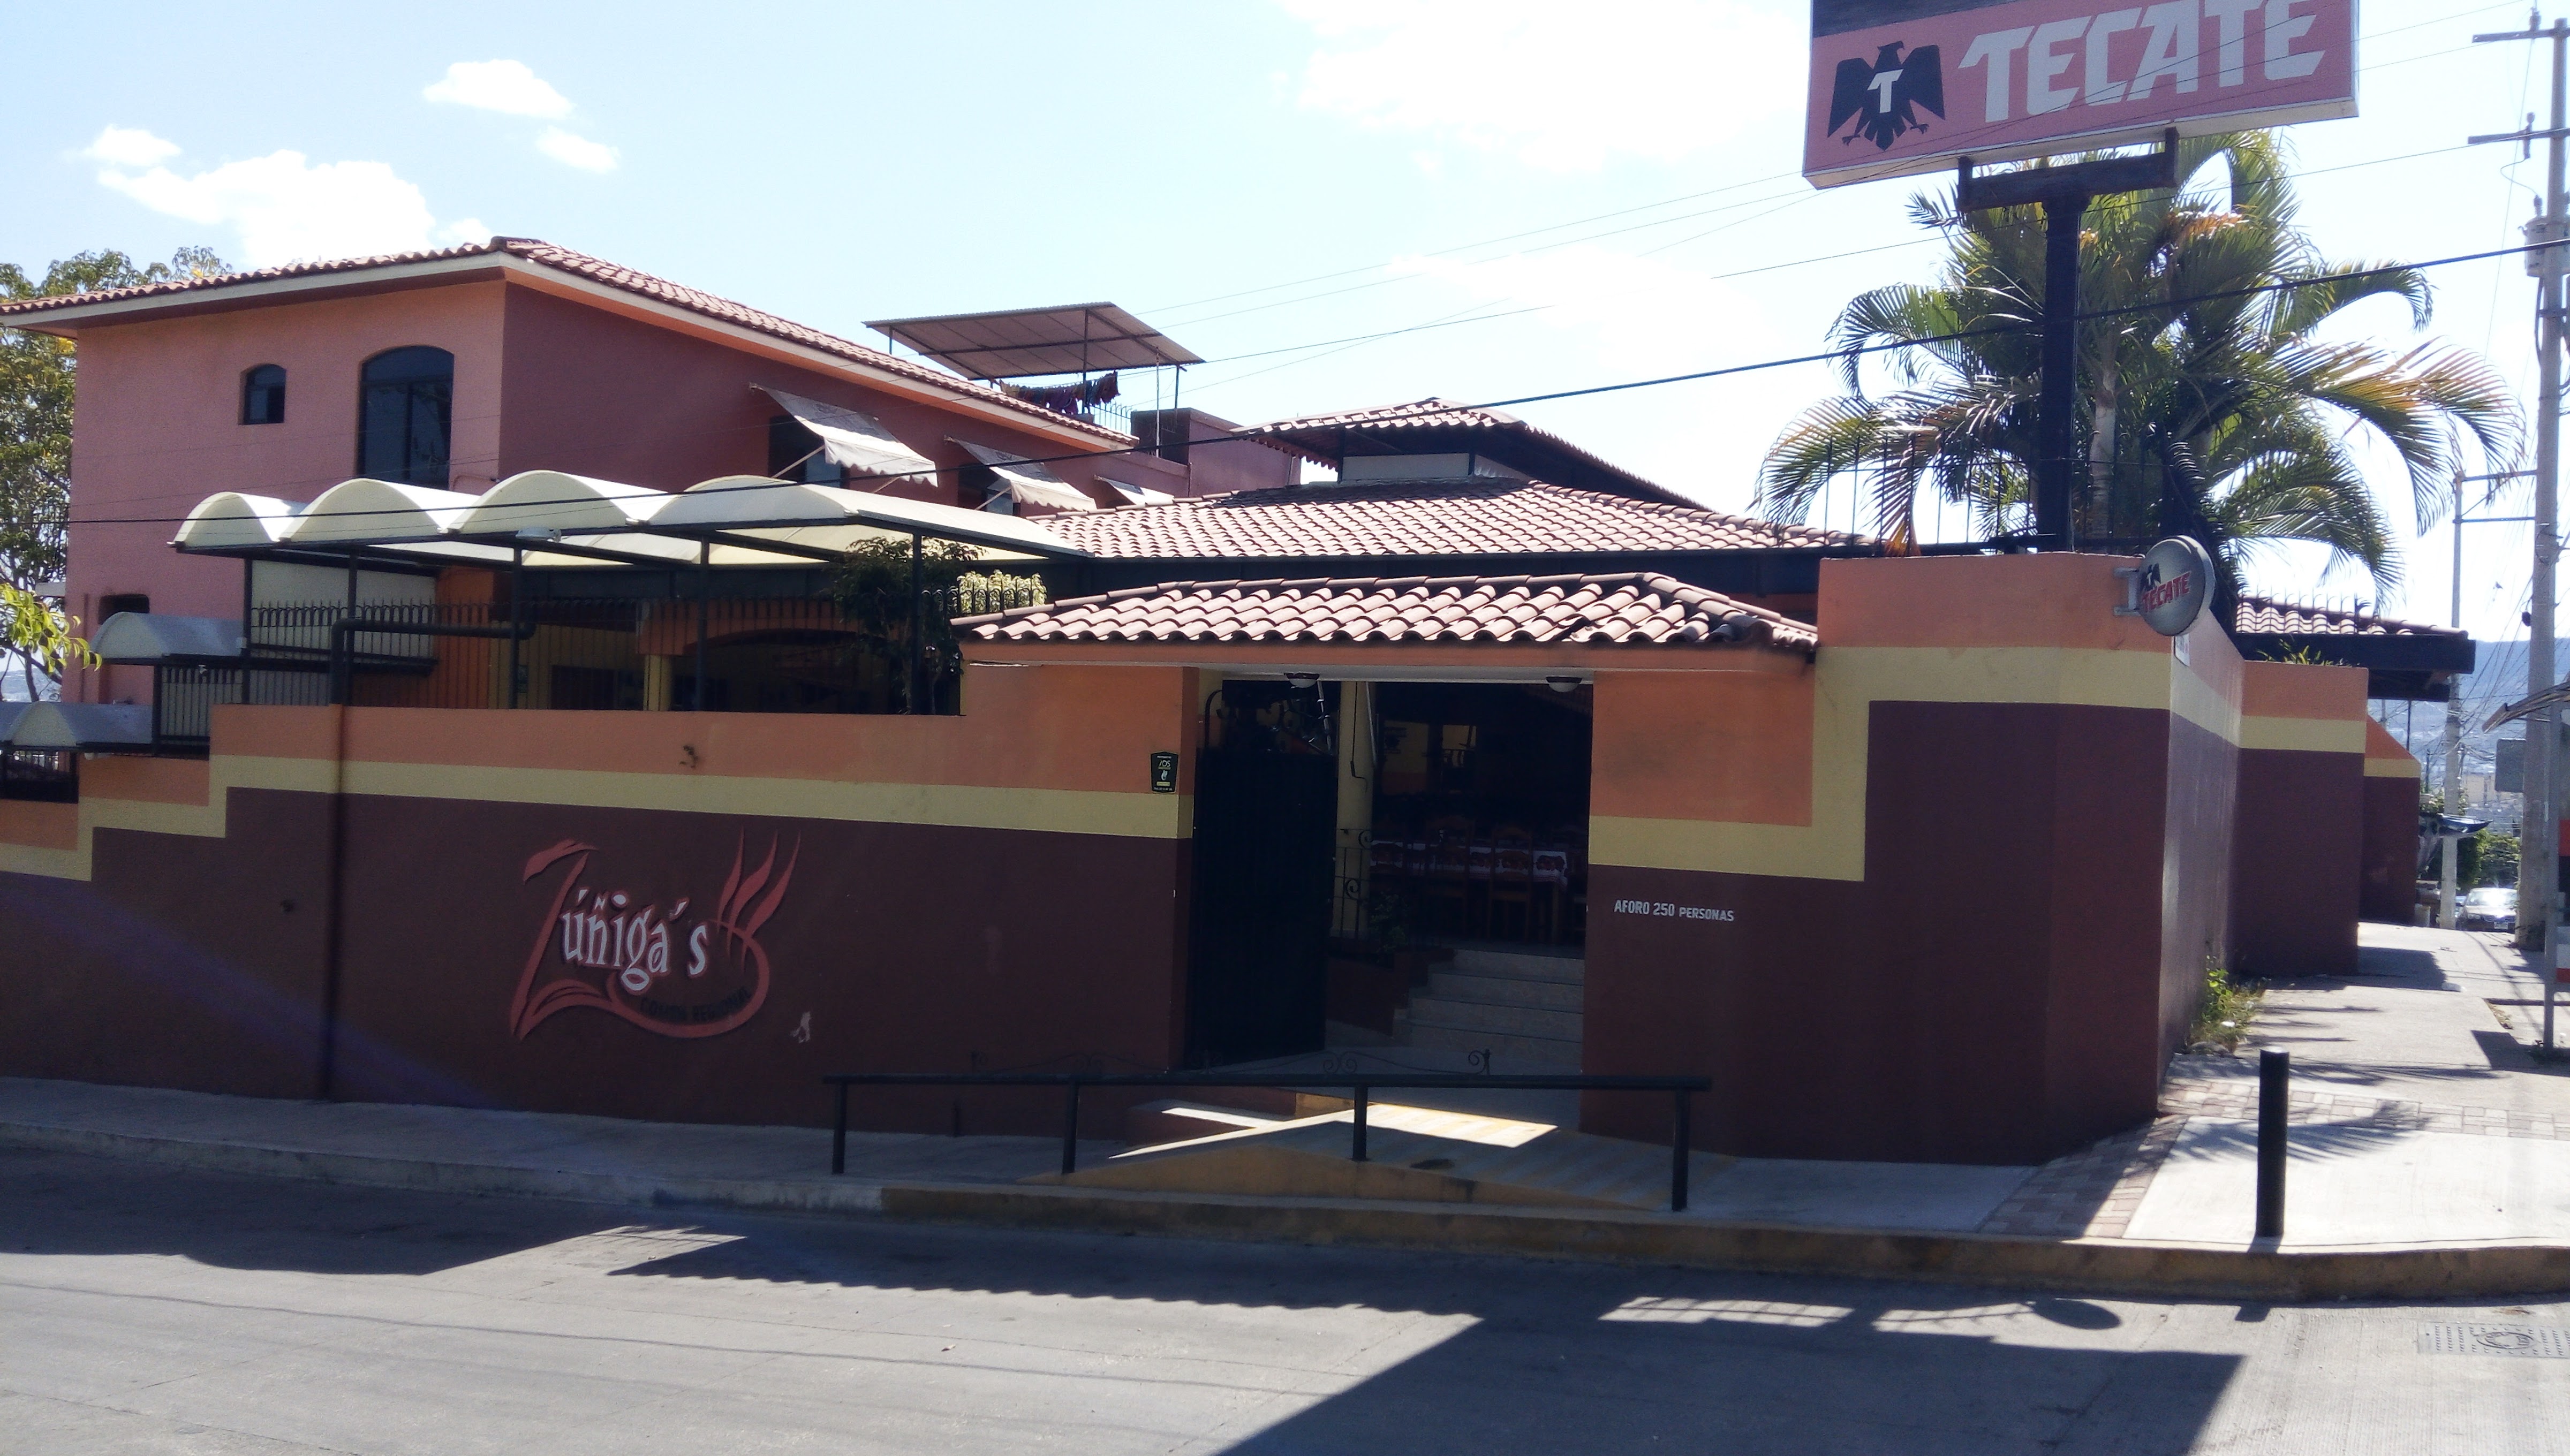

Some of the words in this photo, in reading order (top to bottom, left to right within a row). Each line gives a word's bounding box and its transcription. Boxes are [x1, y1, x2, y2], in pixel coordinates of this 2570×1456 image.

[1958, 0, 2325, 123] TECATE
[2142, 571, 2191, 613] TECATE
[1614, 900, 1650, 915] AFORO
[1653, 903, 1674, 916] 250
[1679, 907, 1734, 921] PERSONAS
